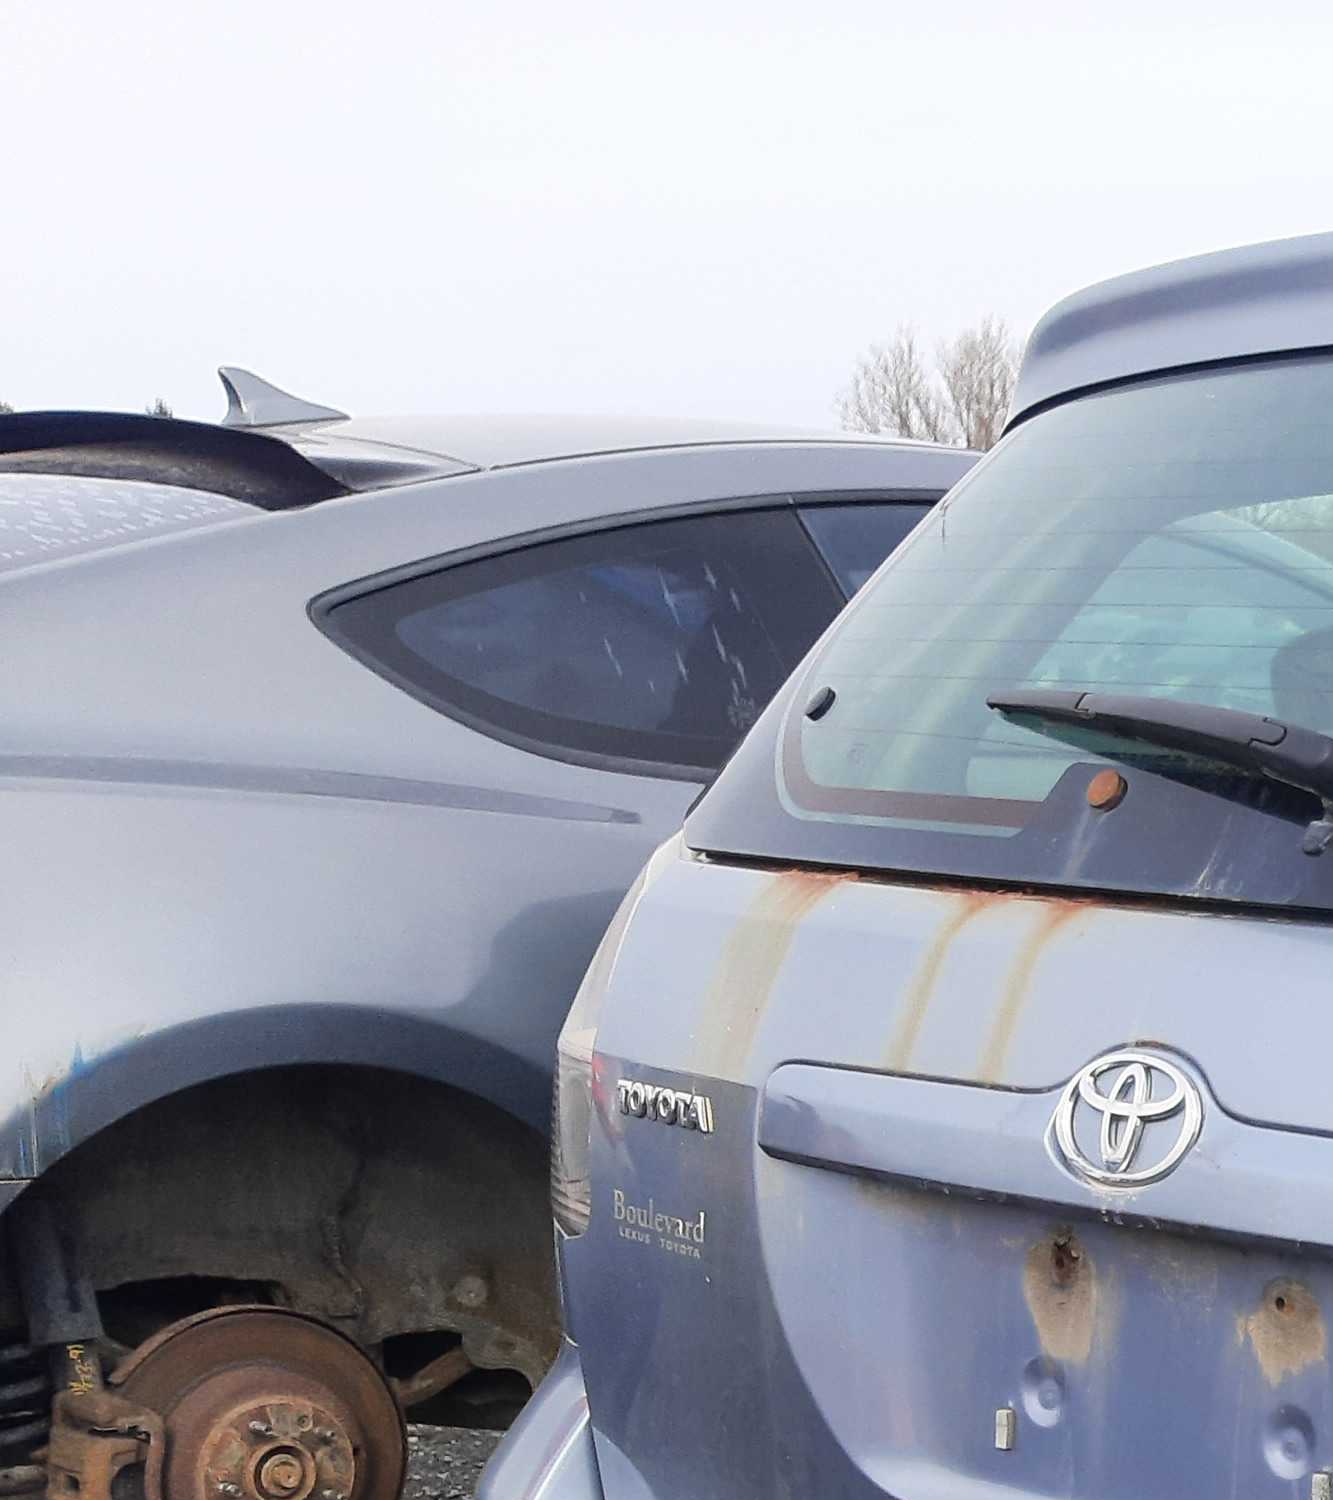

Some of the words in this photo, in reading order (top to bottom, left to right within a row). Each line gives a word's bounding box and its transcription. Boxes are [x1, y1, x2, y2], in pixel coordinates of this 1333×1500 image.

[616, 1079, 714, 1134] TOYOTA
[613, 1189, 705, 1243] Boulevard
[619, 1226, 651, 1244] LEXUS
[660, 1238, 701, 1259] TOYOTA
